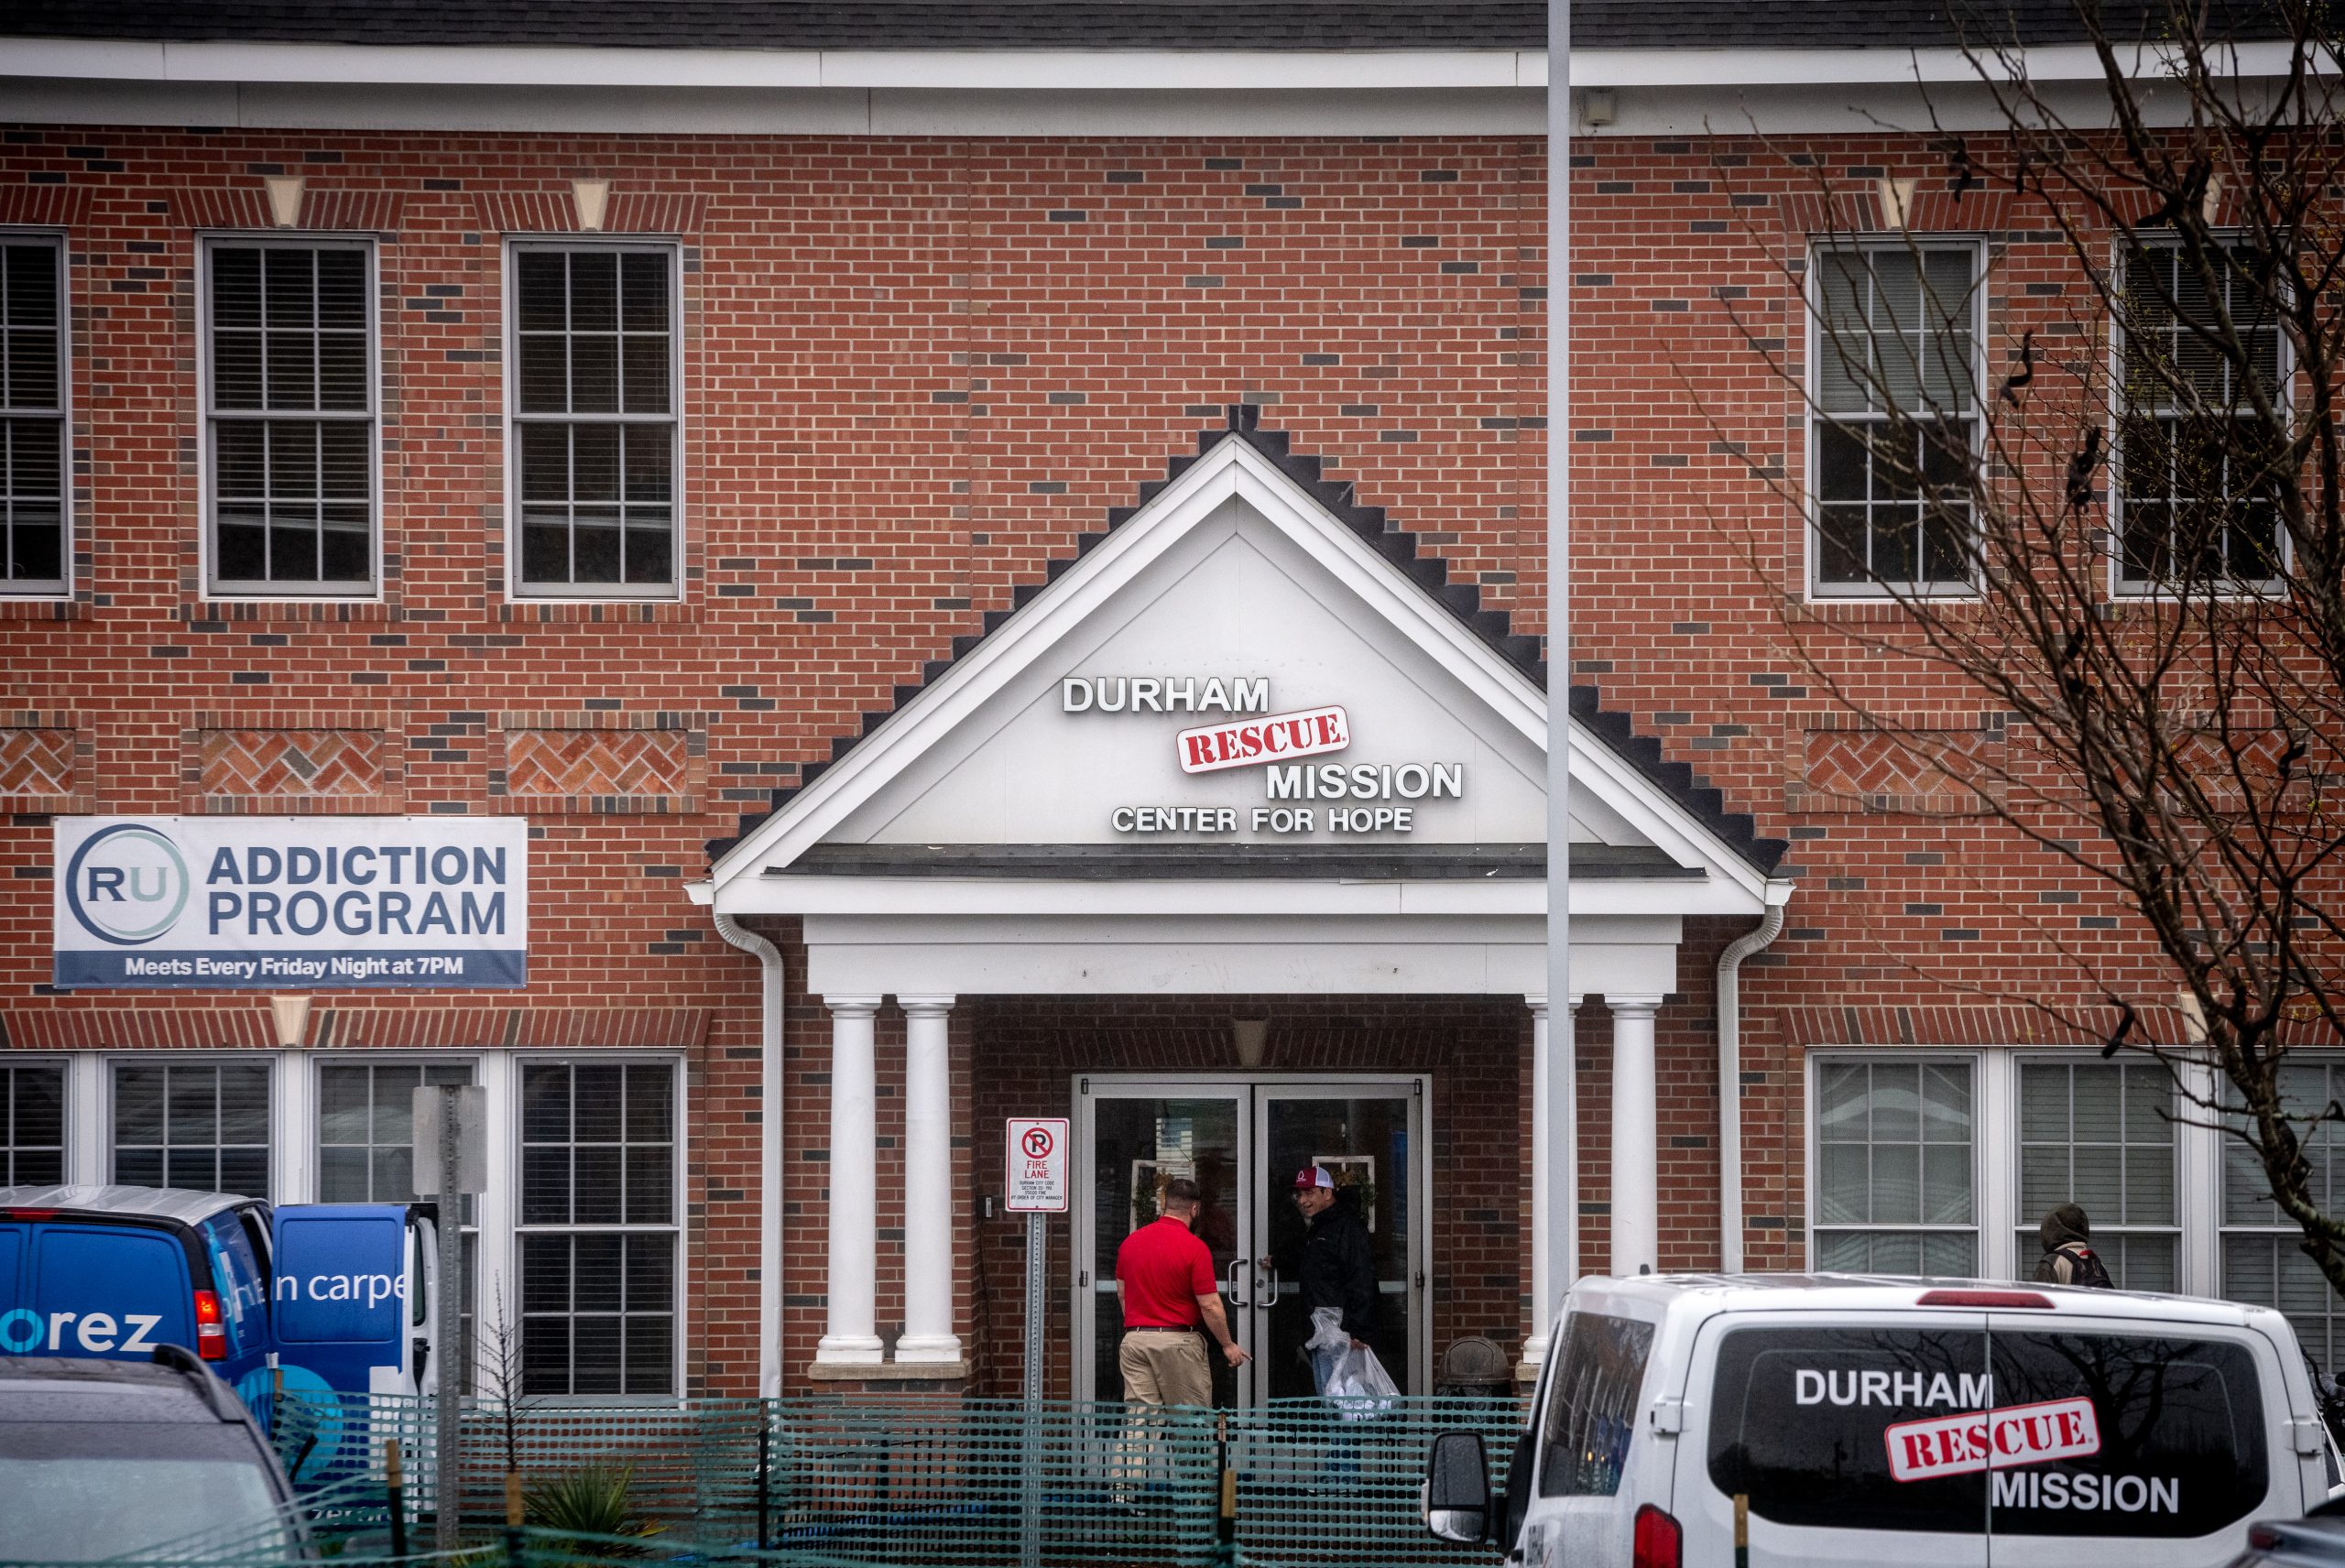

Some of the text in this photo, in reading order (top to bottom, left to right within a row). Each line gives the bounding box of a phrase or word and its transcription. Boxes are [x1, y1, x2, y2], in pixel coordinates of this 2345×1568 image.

[1062, 677, 1270, 713] DURHAM
[1185, 713, 1341, 766] RESCUE
[1265, 763, 1464, 800] MISSION
[1111, 806, 1413, 833] CENTER FOR HOPE
[86, 866, 169, 902] RU
[206, 845, 507, 886] ADDICTION
[208, 890, 506, 936] PROGRAM
[125, 956, 464, 979] Meets Every Friday Night at 7PM
[1024, 1171, 1050, 1179] LANE
[1027, 1160, 1048, 1170] FIRE
[0, 1308, 163, 1353] orez
[1795, 1369, 1993, 1410] DURHAM
[1902, 1410, 2087, 1469] RESCUE
[1991, 1472, 2179, 1513] MISSION
